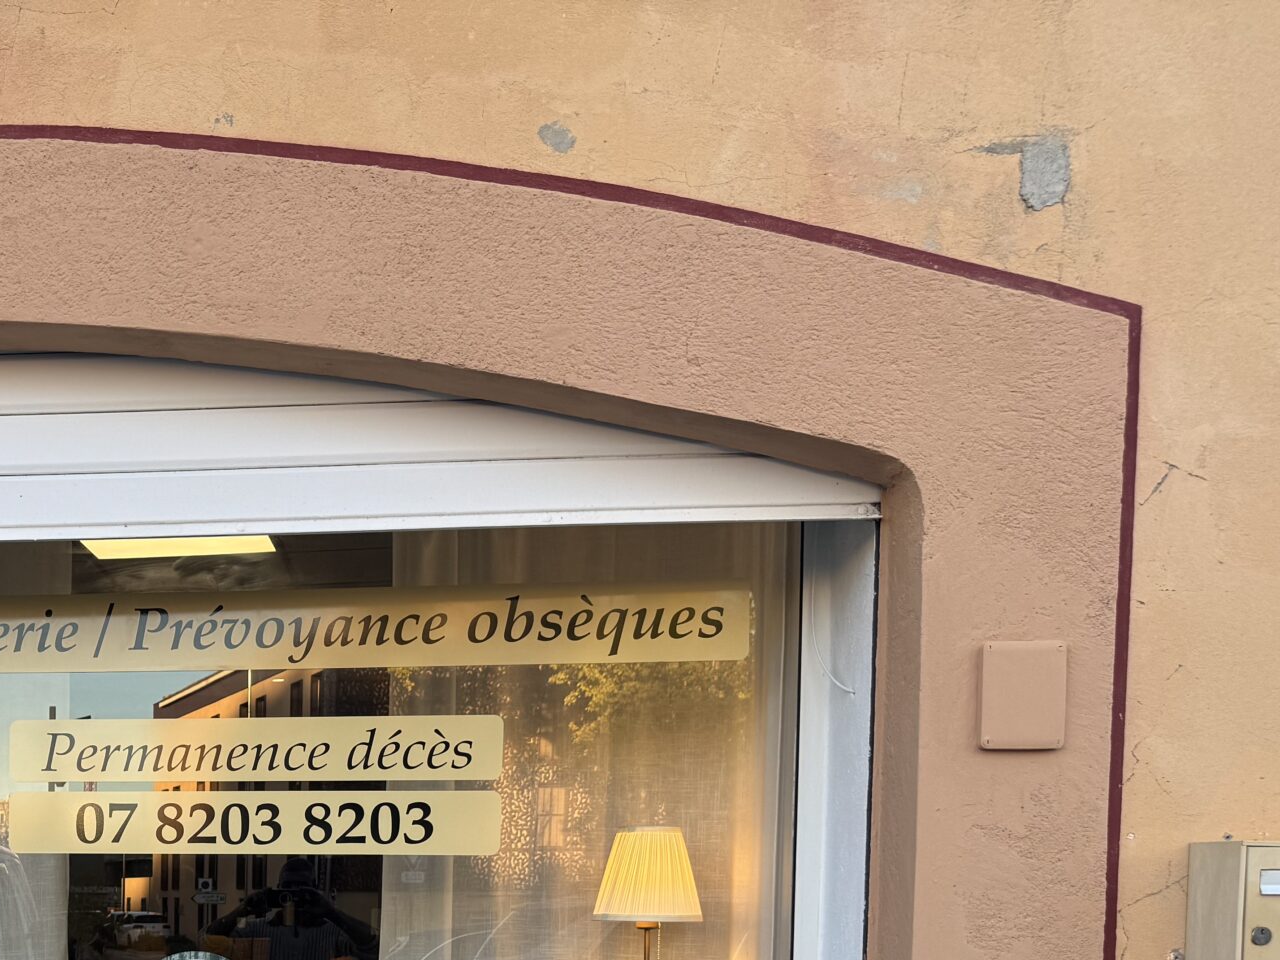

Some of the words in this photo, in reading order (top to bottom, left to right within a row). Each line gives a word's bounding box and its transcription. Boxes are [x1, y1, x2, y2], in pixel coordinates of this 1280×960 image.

[128, 604, 448, 664] Prévoyance
[467, 594, 724, 656] obsèques
[41, 732, 330, 773] Permanence
[346, 728, 473, 771] décès
[75, 802, 138, 845] 07
[155, 802, 282, 846] 8203
[302, 801, 434, 845] 8203
